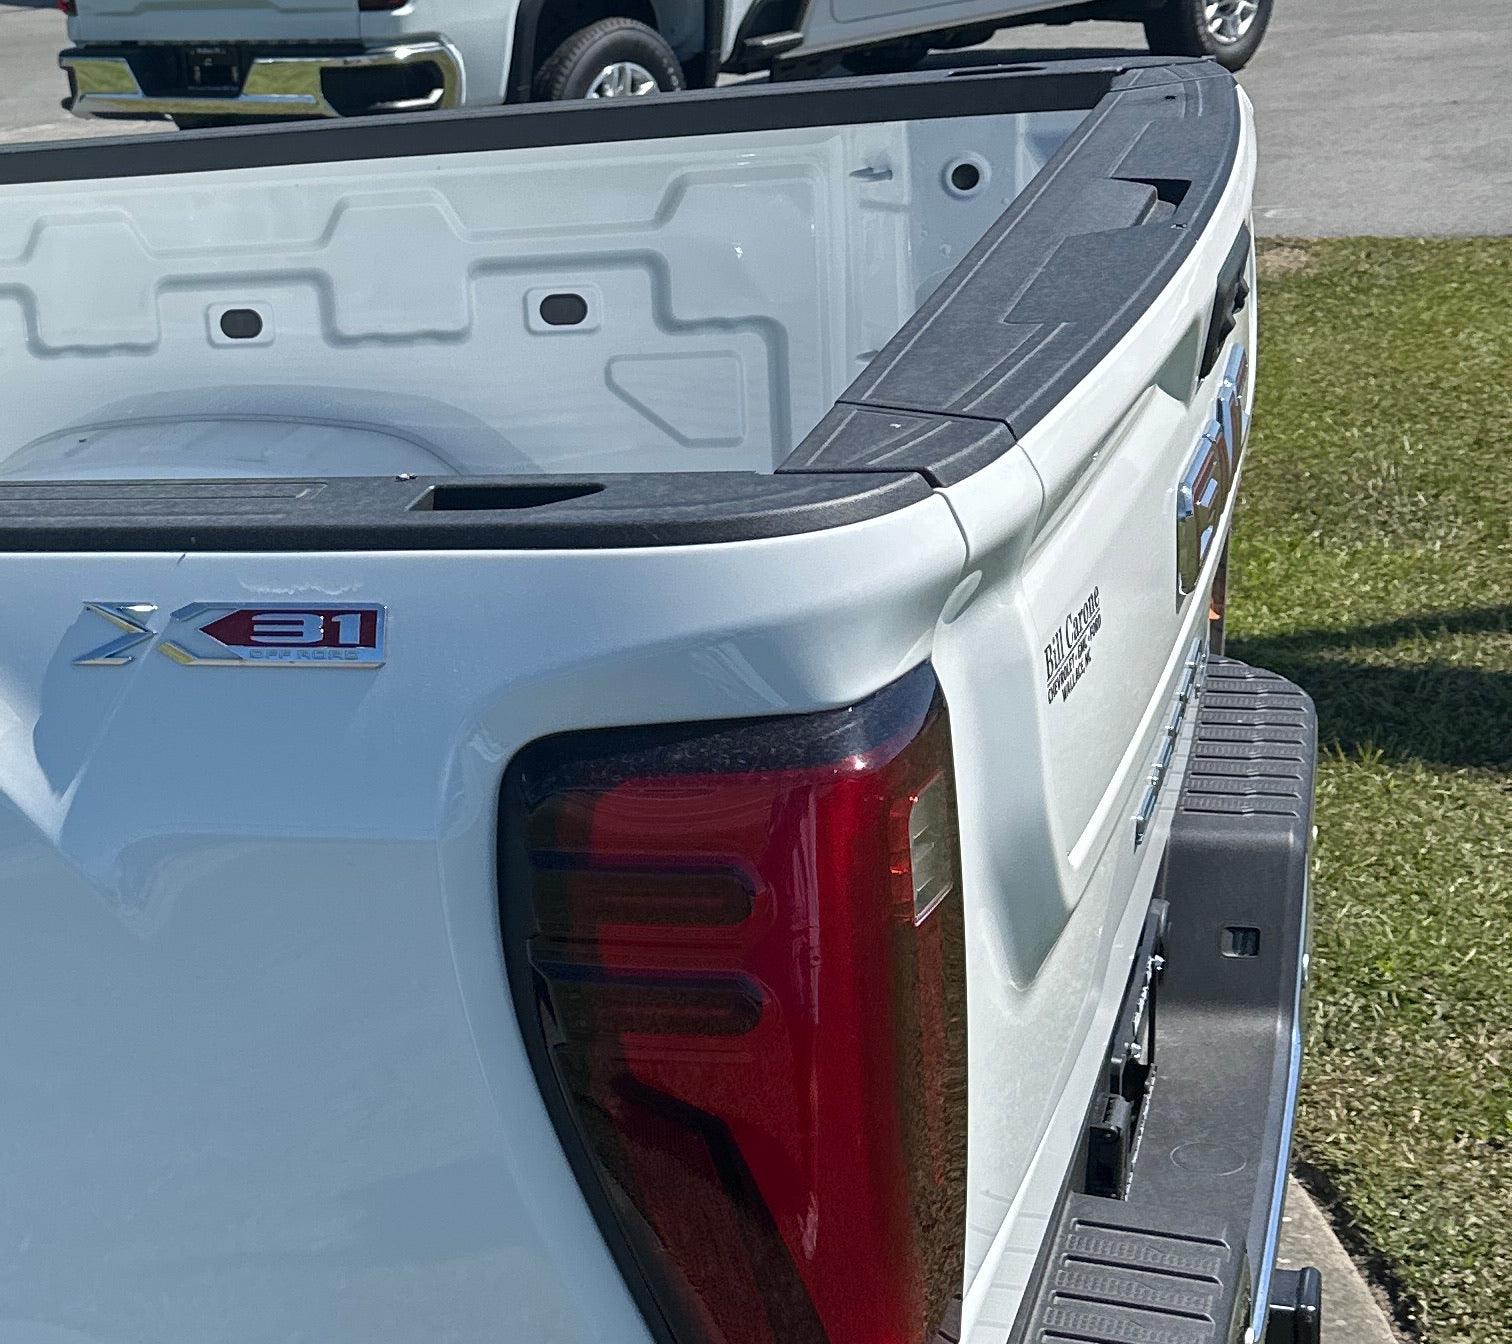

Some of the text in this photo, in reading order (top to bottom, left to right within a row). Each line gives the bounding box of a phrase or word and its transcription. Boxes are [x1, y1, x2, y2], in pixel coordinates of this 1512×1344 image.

[70, 600, 388, 669] X31
[1044, 585, 1100, 682] Bill Carone
